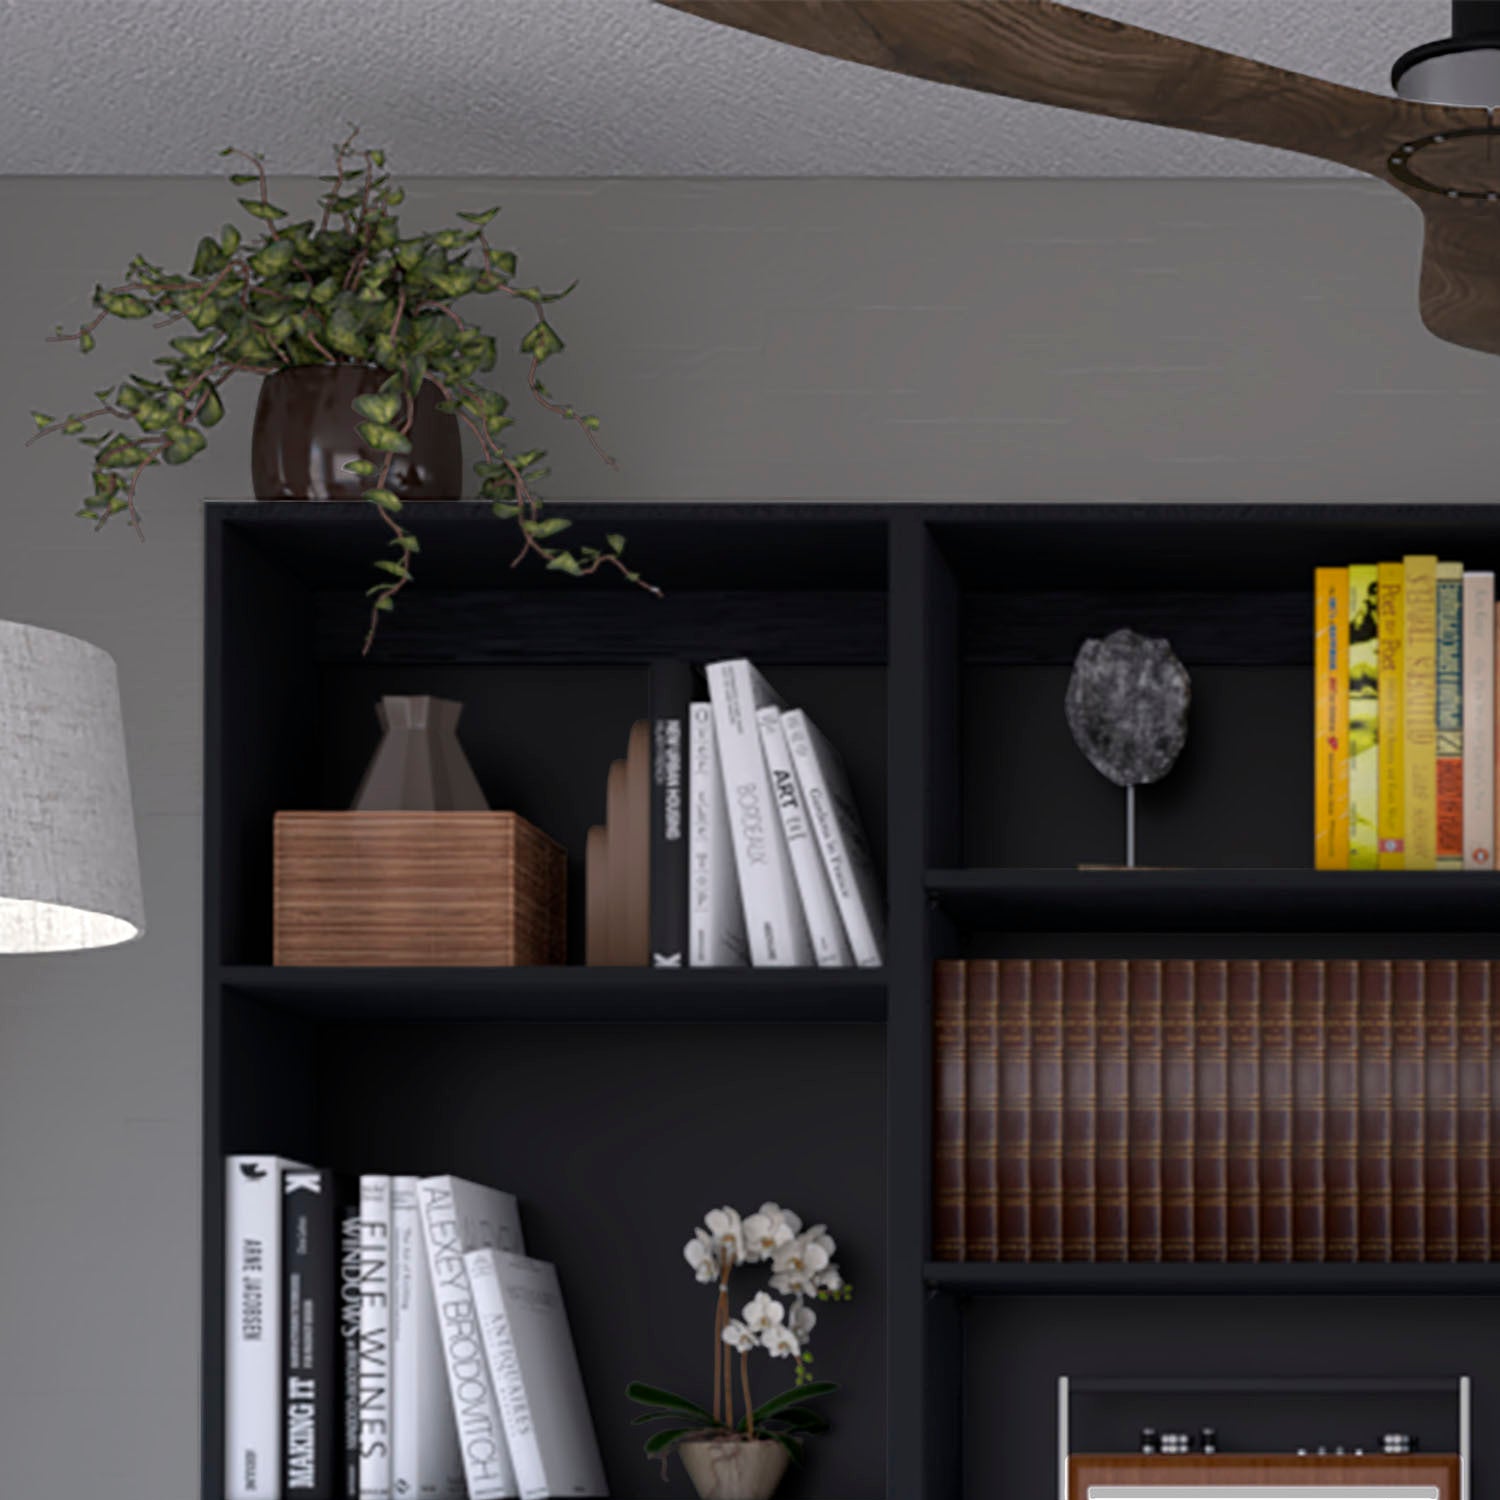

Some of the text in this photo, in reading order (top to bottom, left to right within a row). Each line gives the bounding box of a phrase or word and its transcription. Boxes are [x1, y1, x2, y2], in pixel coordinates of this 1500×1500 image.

[773, 769, 798, 810] ART
[242, 1239, 263, 1341] ARNE JACOBSEN
[341, 1217, 360, 1338] WINDOWS
[423, 1185, 498, 1481] ALEXEY BRODOVITCH
[360, 1219, 388, 1459] FINE WINES
[288, 1376, 315, 1488] MAKING IT
